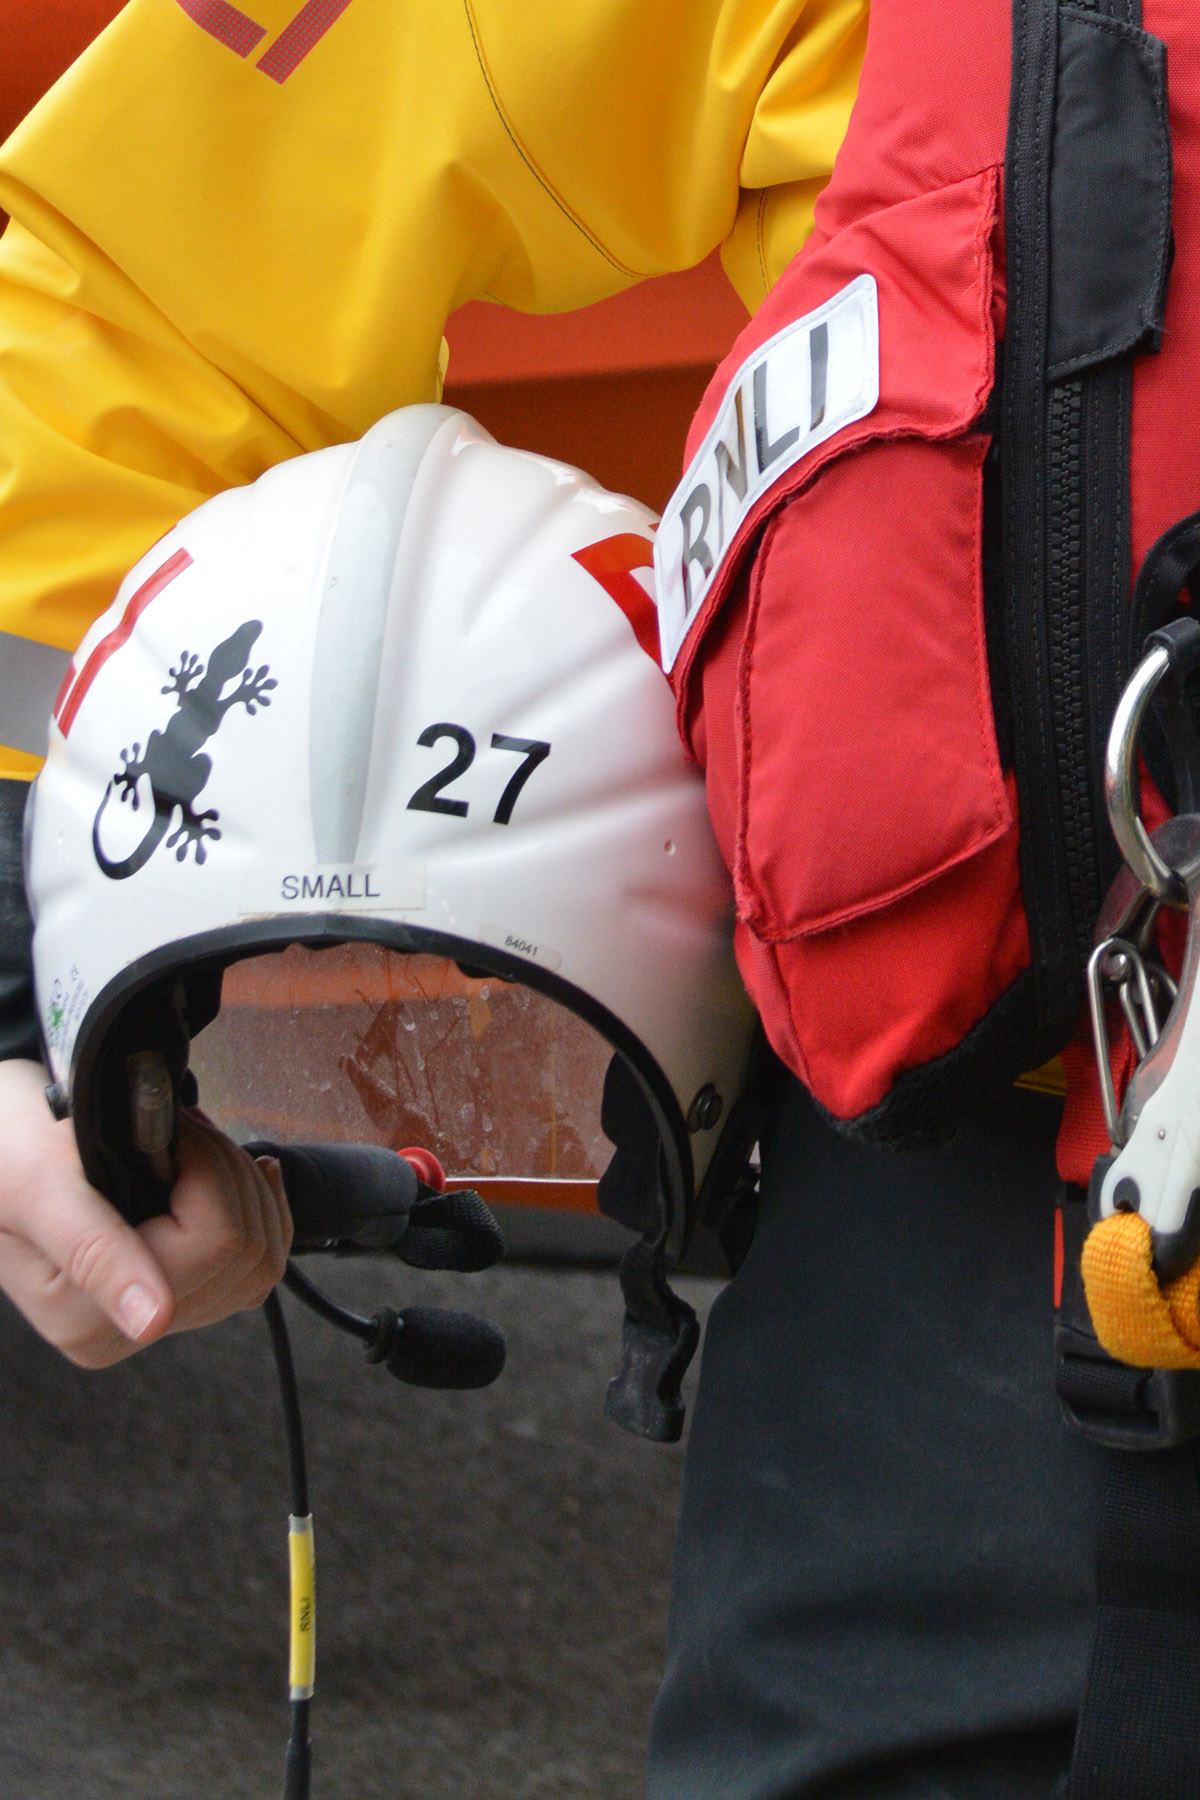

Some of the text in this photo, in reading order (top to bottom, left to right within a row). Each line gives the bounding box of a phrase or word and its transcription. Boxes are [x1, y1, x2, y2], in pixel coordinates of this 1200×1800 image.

[680, 322, 828, 614] RNLI
[405, 722, 551, 825] 27
[281, 873, 381, 900] SMALL
[299, 1597, 310, 1632] RNLI
